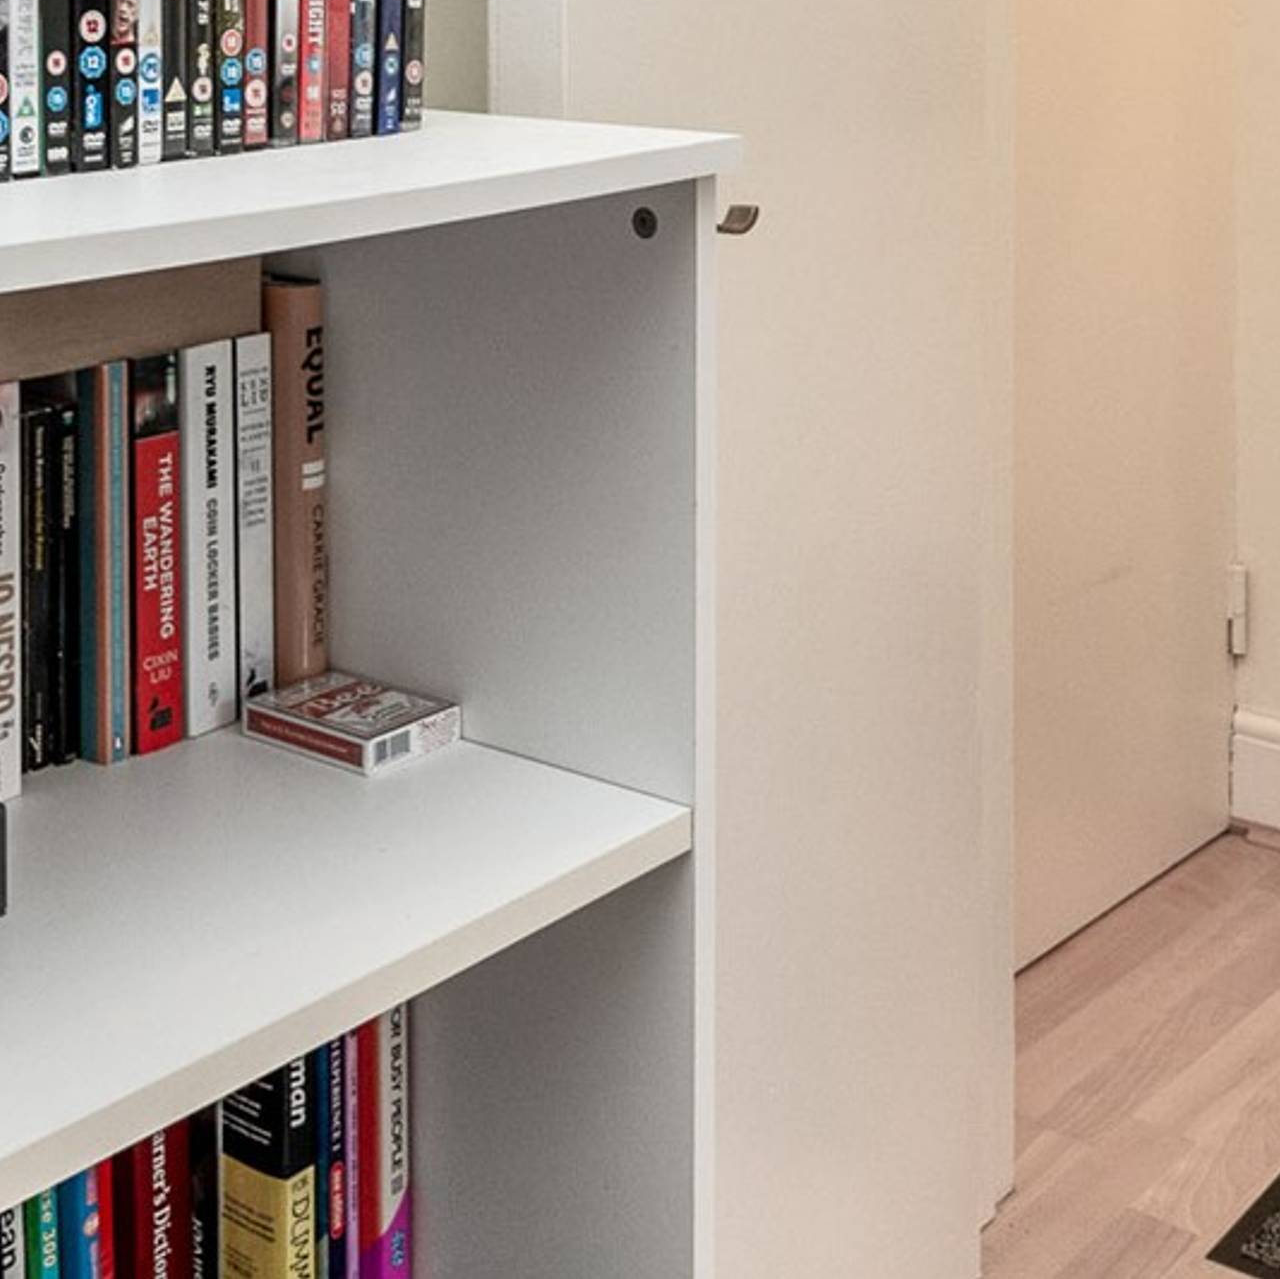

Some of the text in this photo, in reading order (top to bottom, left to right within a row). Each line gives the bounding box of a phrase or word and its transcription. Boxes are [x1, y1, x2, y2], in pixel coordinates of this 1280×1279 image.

[301, 327, 325, 444] EQUAL
[142, 516, 158, 591] EARTH
[158, 452, 174, 640] THE WANDERING
[204, 365, 219, 661] RYU MURAKAMI COIN LOCKER BABIES
[331, 1052, 342, 1144] EXPERIENCE
[390, 1043, 404, 1170] BUSY PEOPLE
[41, 1228, 57, 1268] 300
